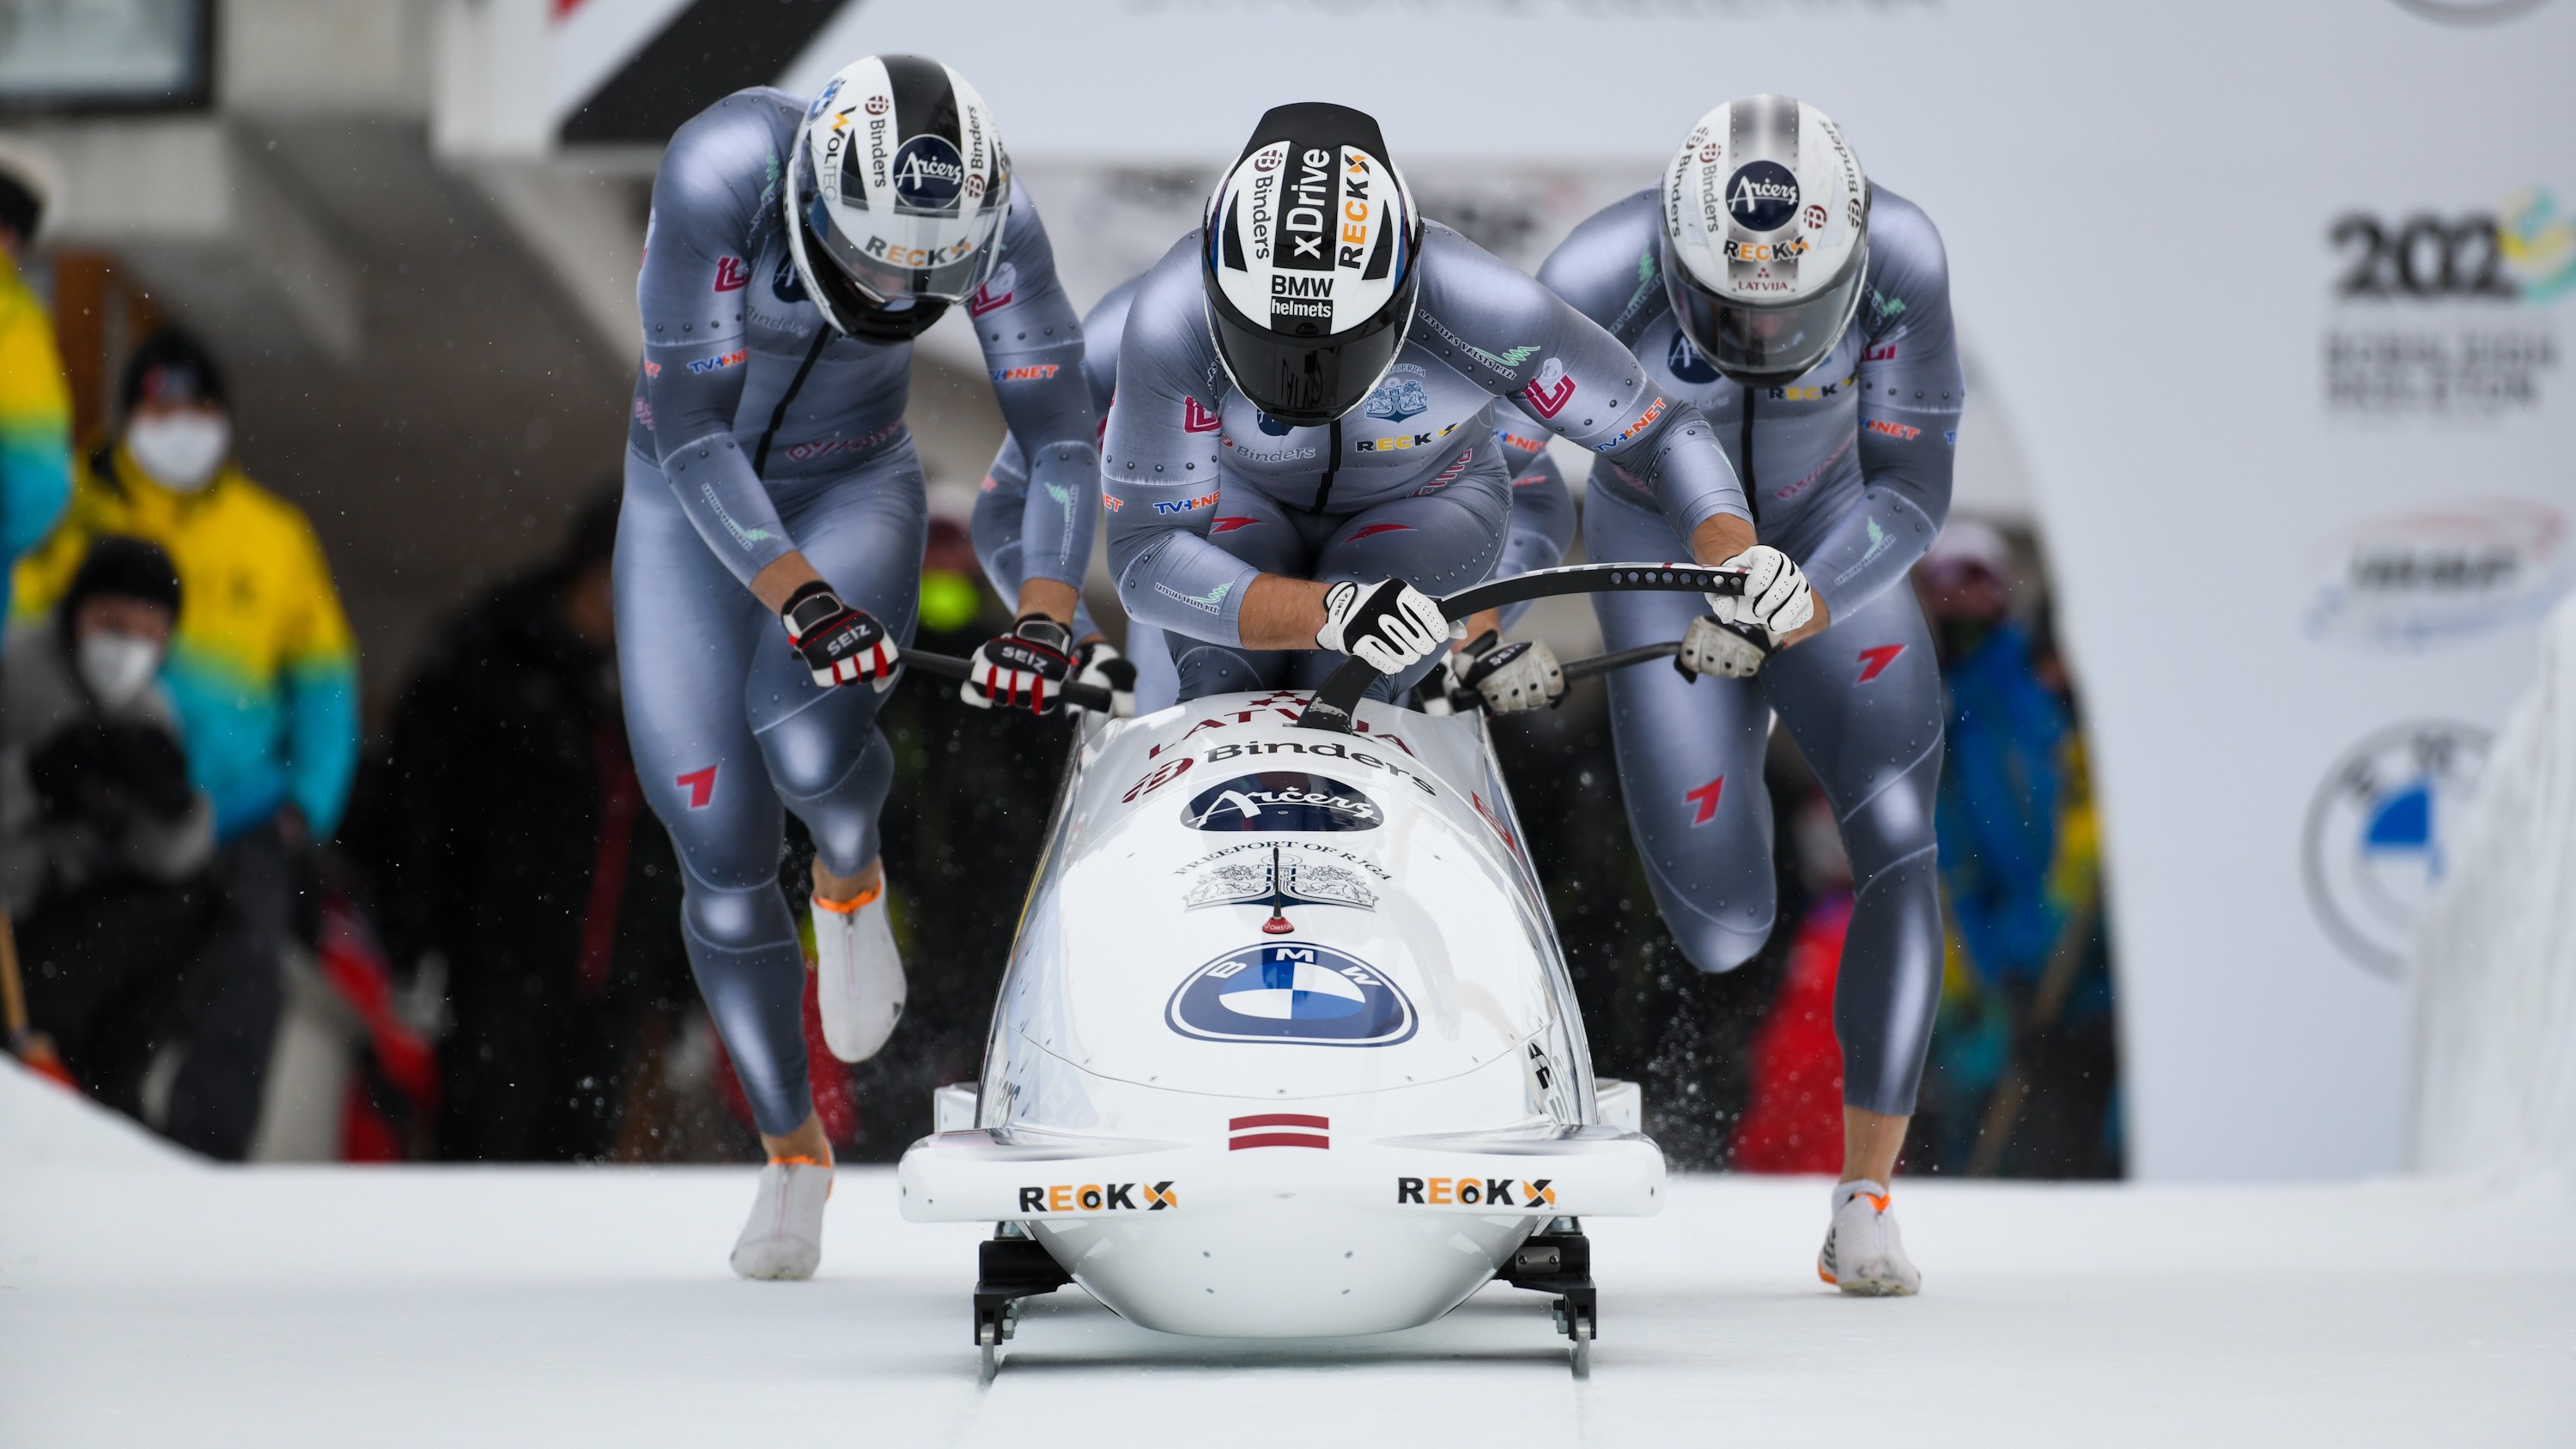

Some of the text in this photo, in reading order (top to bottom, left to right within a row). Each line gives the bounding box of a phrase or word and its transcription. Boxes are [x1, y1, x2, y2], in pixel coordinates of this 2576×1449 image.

[870, 118, 888, 188] Binders
[968, 106, 984, 170] Binders
[1818, 119, 1858, 192] Binders
[1252, 174, 1273, 260] Binders
[1285, 149, 1330, 259] xDrive
[1670, 154, 1692, 237] Binders
[1703, 164, 1719, 233] Binders
[1271, 274, 1334, 298] BMW
[1271, 299, 1332, 318] helmets
[1738, 281, 1788, 292] LATVIJA
[1419, 308, 1517, 380] LATVIJAS VALSTS MEŽI
[1407, 364, 1426, 378] RIGA
[1235, 444, 1316, 463] Binders
[1356, 431, 1432, 453] RECK
[1154, 583, 1182, 602] LATVIJAS
[1182, 596, 1205, 610] VALSTS
[1204, 741, 1437, 797] Binders
[1174, 840, 1393, 881] FREEPORT OF RIGA
[1206, 948, 1382, 987] BMW
